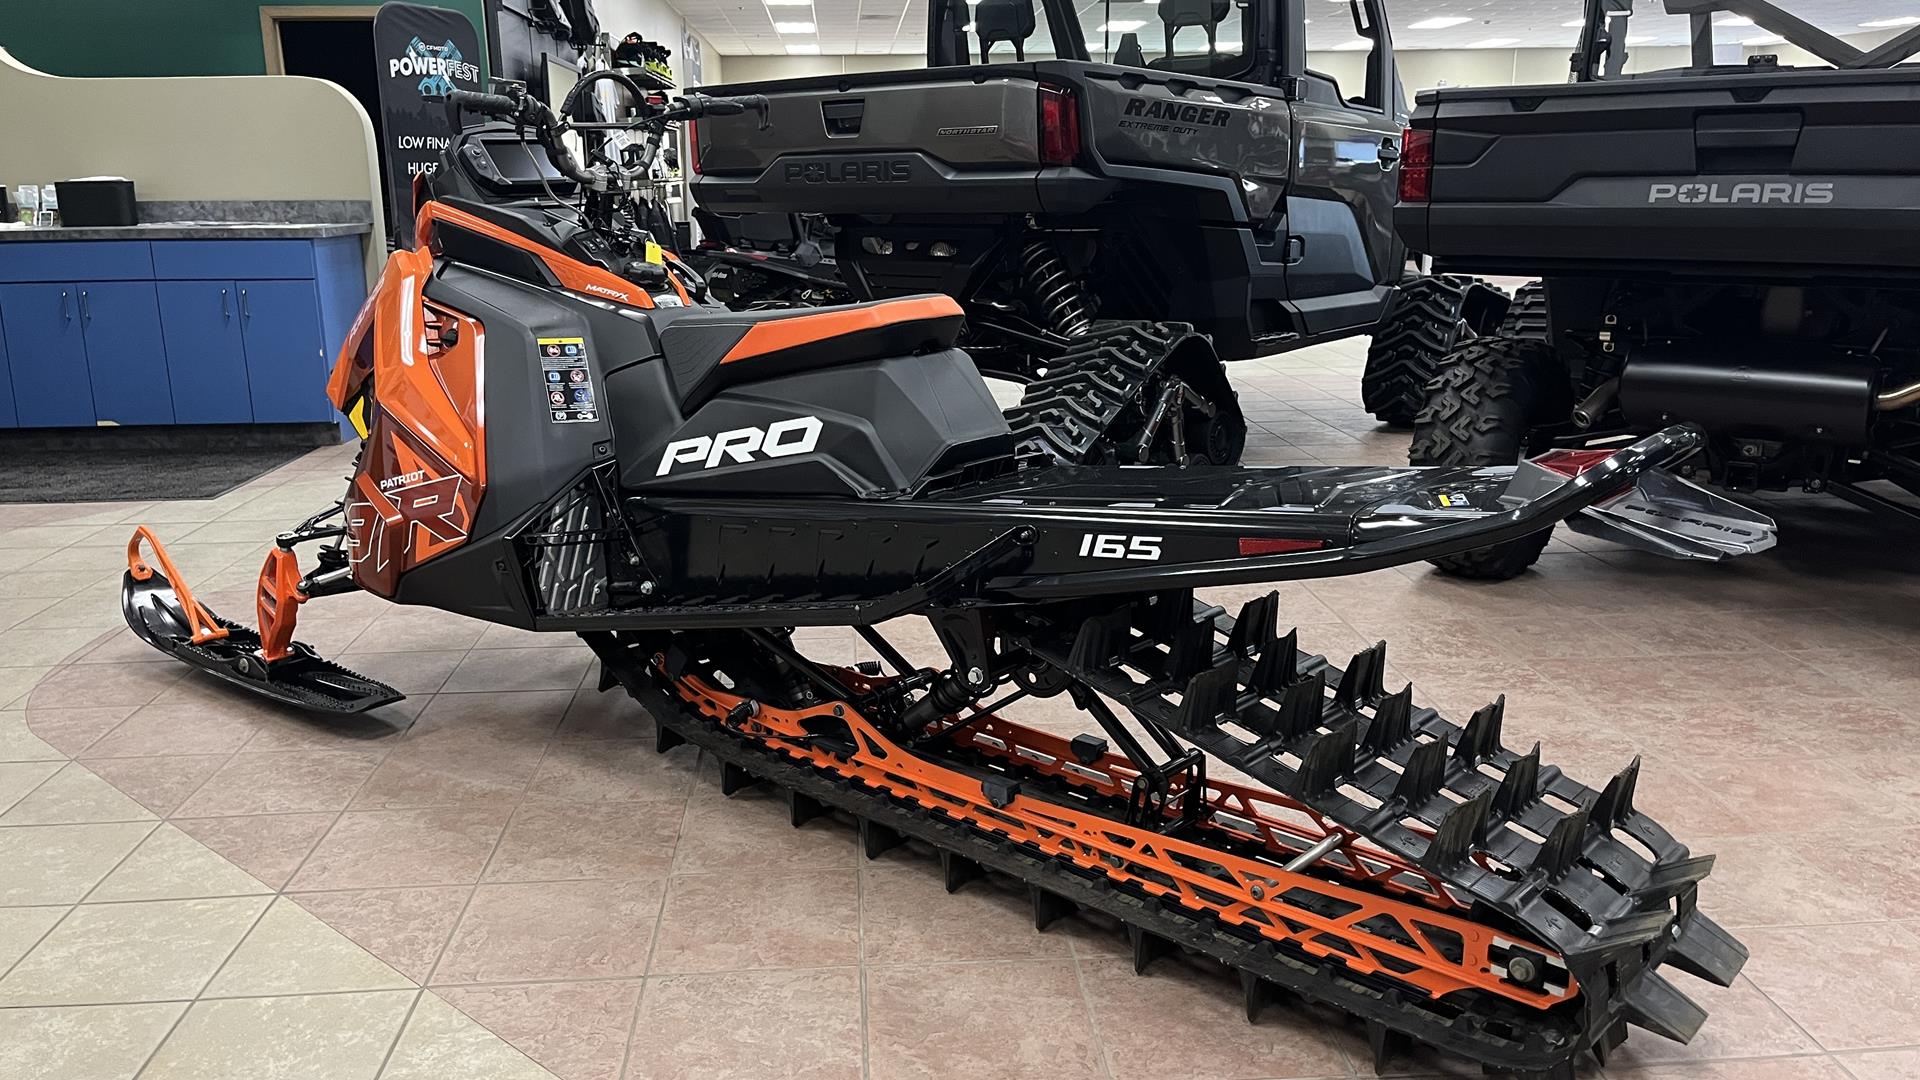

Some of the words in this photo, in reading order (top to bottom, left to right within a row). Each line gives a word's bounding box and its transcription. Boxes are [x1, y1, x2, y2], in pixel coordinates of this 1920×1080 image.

[389, 55, 479, 84] POWERFEST
[1123, 98, 1231, 127] RANGER
[939, 127, 996, 136] NORTHSTAR
[1118, 120, 1170, 132] EXTREME
[1172, 126, 1200, 135] DUTY
[398, 135, 425, 149] LOW
[784, 160, 912, 184] POLARIS
[1648, 183, 1834, 204] POLARIS
[585, 284, 629, 302] MATRYX
[655, 415, 824, 477] PRO
[380, 469, 425, 490] PATRIOT
[1078, 533, 1163, 561] 165
